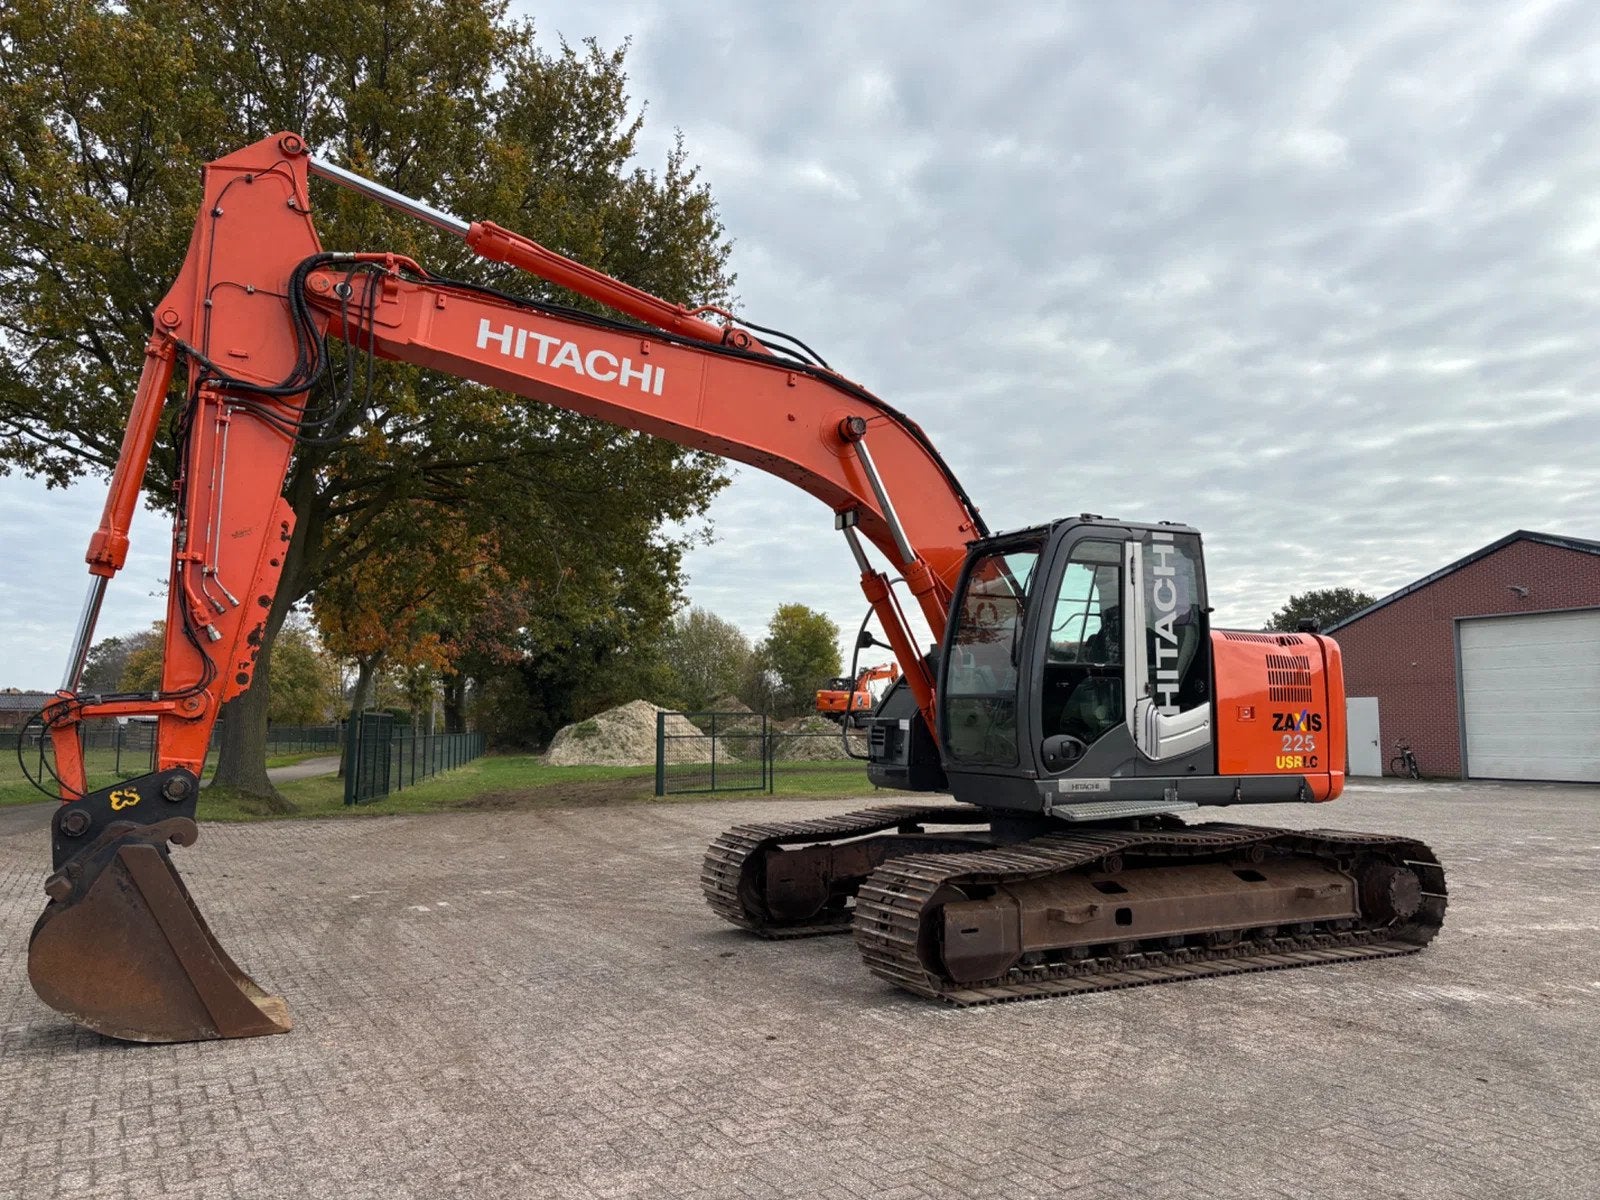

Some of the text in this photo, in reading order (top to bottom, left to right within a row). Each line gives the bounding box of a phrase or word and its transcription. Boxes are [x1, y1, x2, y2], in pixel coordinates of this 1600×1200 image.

[477, 318, 666, 397] HITACHI
[1152, 531, 1181, 716] HITACHI
[1272, 709, 1322, 732] ZAXIS
[1281, 734, 1316, 752] 225
[1071, 783, 1100, 791] HITACHI
